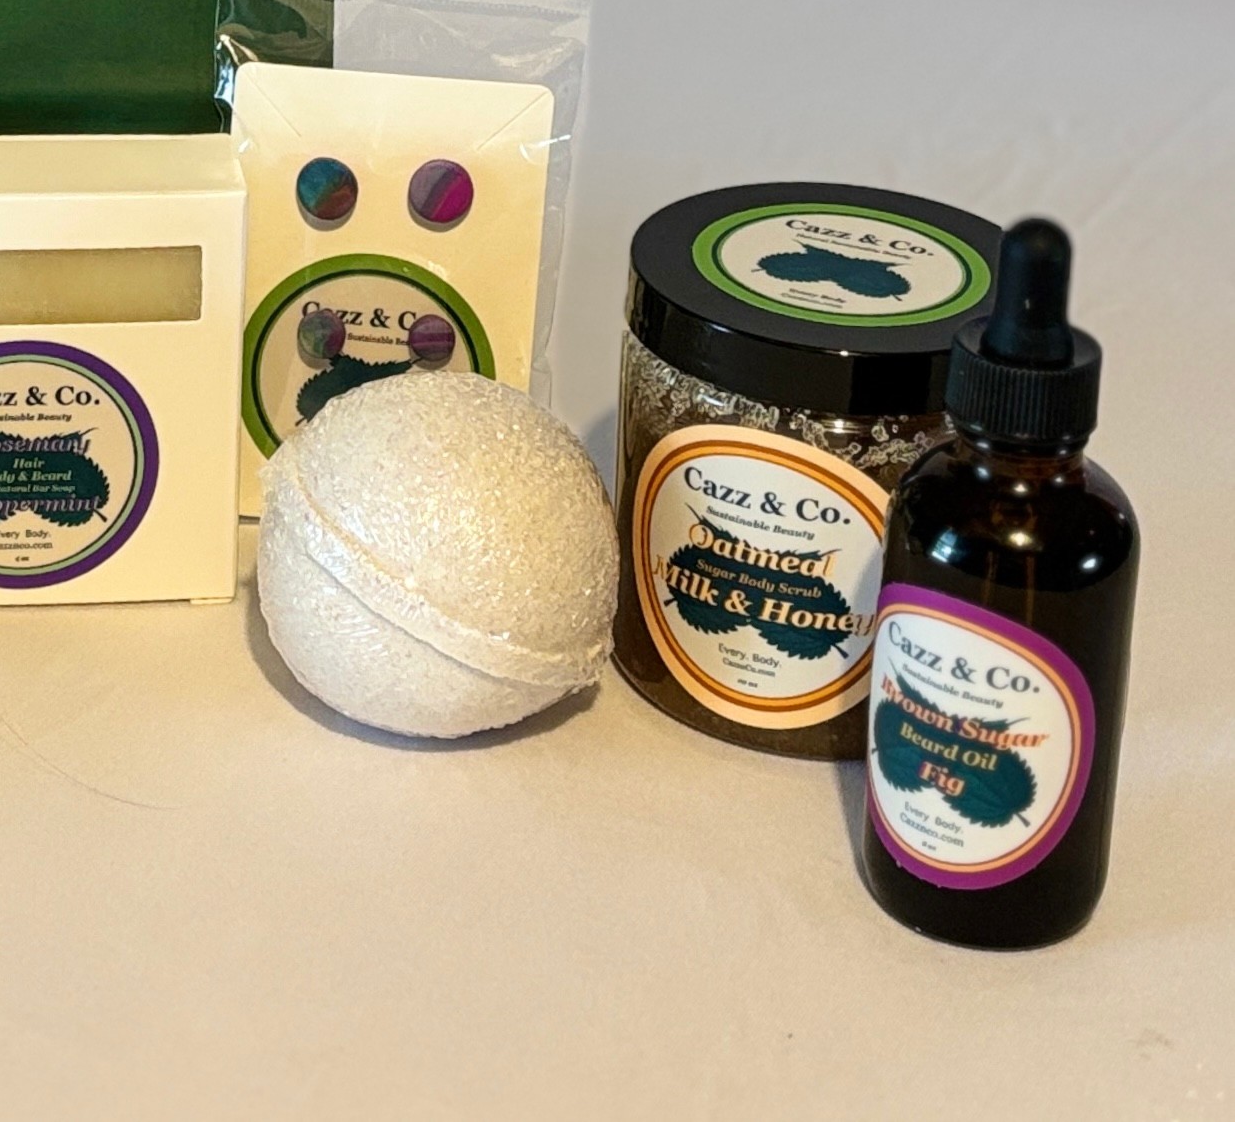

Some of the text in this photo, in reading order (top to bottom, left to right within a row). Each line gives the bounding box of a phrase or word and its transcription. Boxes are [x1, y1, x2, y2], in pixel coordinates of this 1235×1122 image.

[786, 220, 852, 240] Cazz
[859, 235, 882, 246] &
[889, 240, 934, 256] Co.
[302, 301, 363, 326] Czz
[370, 308, 391, 328] &
[26, 386, 48, 406] &
[55, 386, 100, 405] Co.
[38, 413, 71, 422] Beauty
[14, 458, 44, 468] Hair
[18, 471, 28, 481] &
[32, 470, 72, 481] Beard
[684, 467, 850, 525] Cazz & Co.
[706, 506, 815, 540] Sustainable Beauty
[689, 524, 838, 578] Oatmeal
[654, 554, 874, 636] Milk & Honey
[696, 558, 822, 599] Sugar Body Scrub
[888, 621, 1040, 693] Cazz & Co.
[902, 663, 1003, 709] Sustainable Beauty
[880, 672, 1049, 752] Brown Sugar
[900, 722, 998, 771] Beard Oil
[919, 761, 965, 797] Fig
[905, 801, 929, 821] Every
